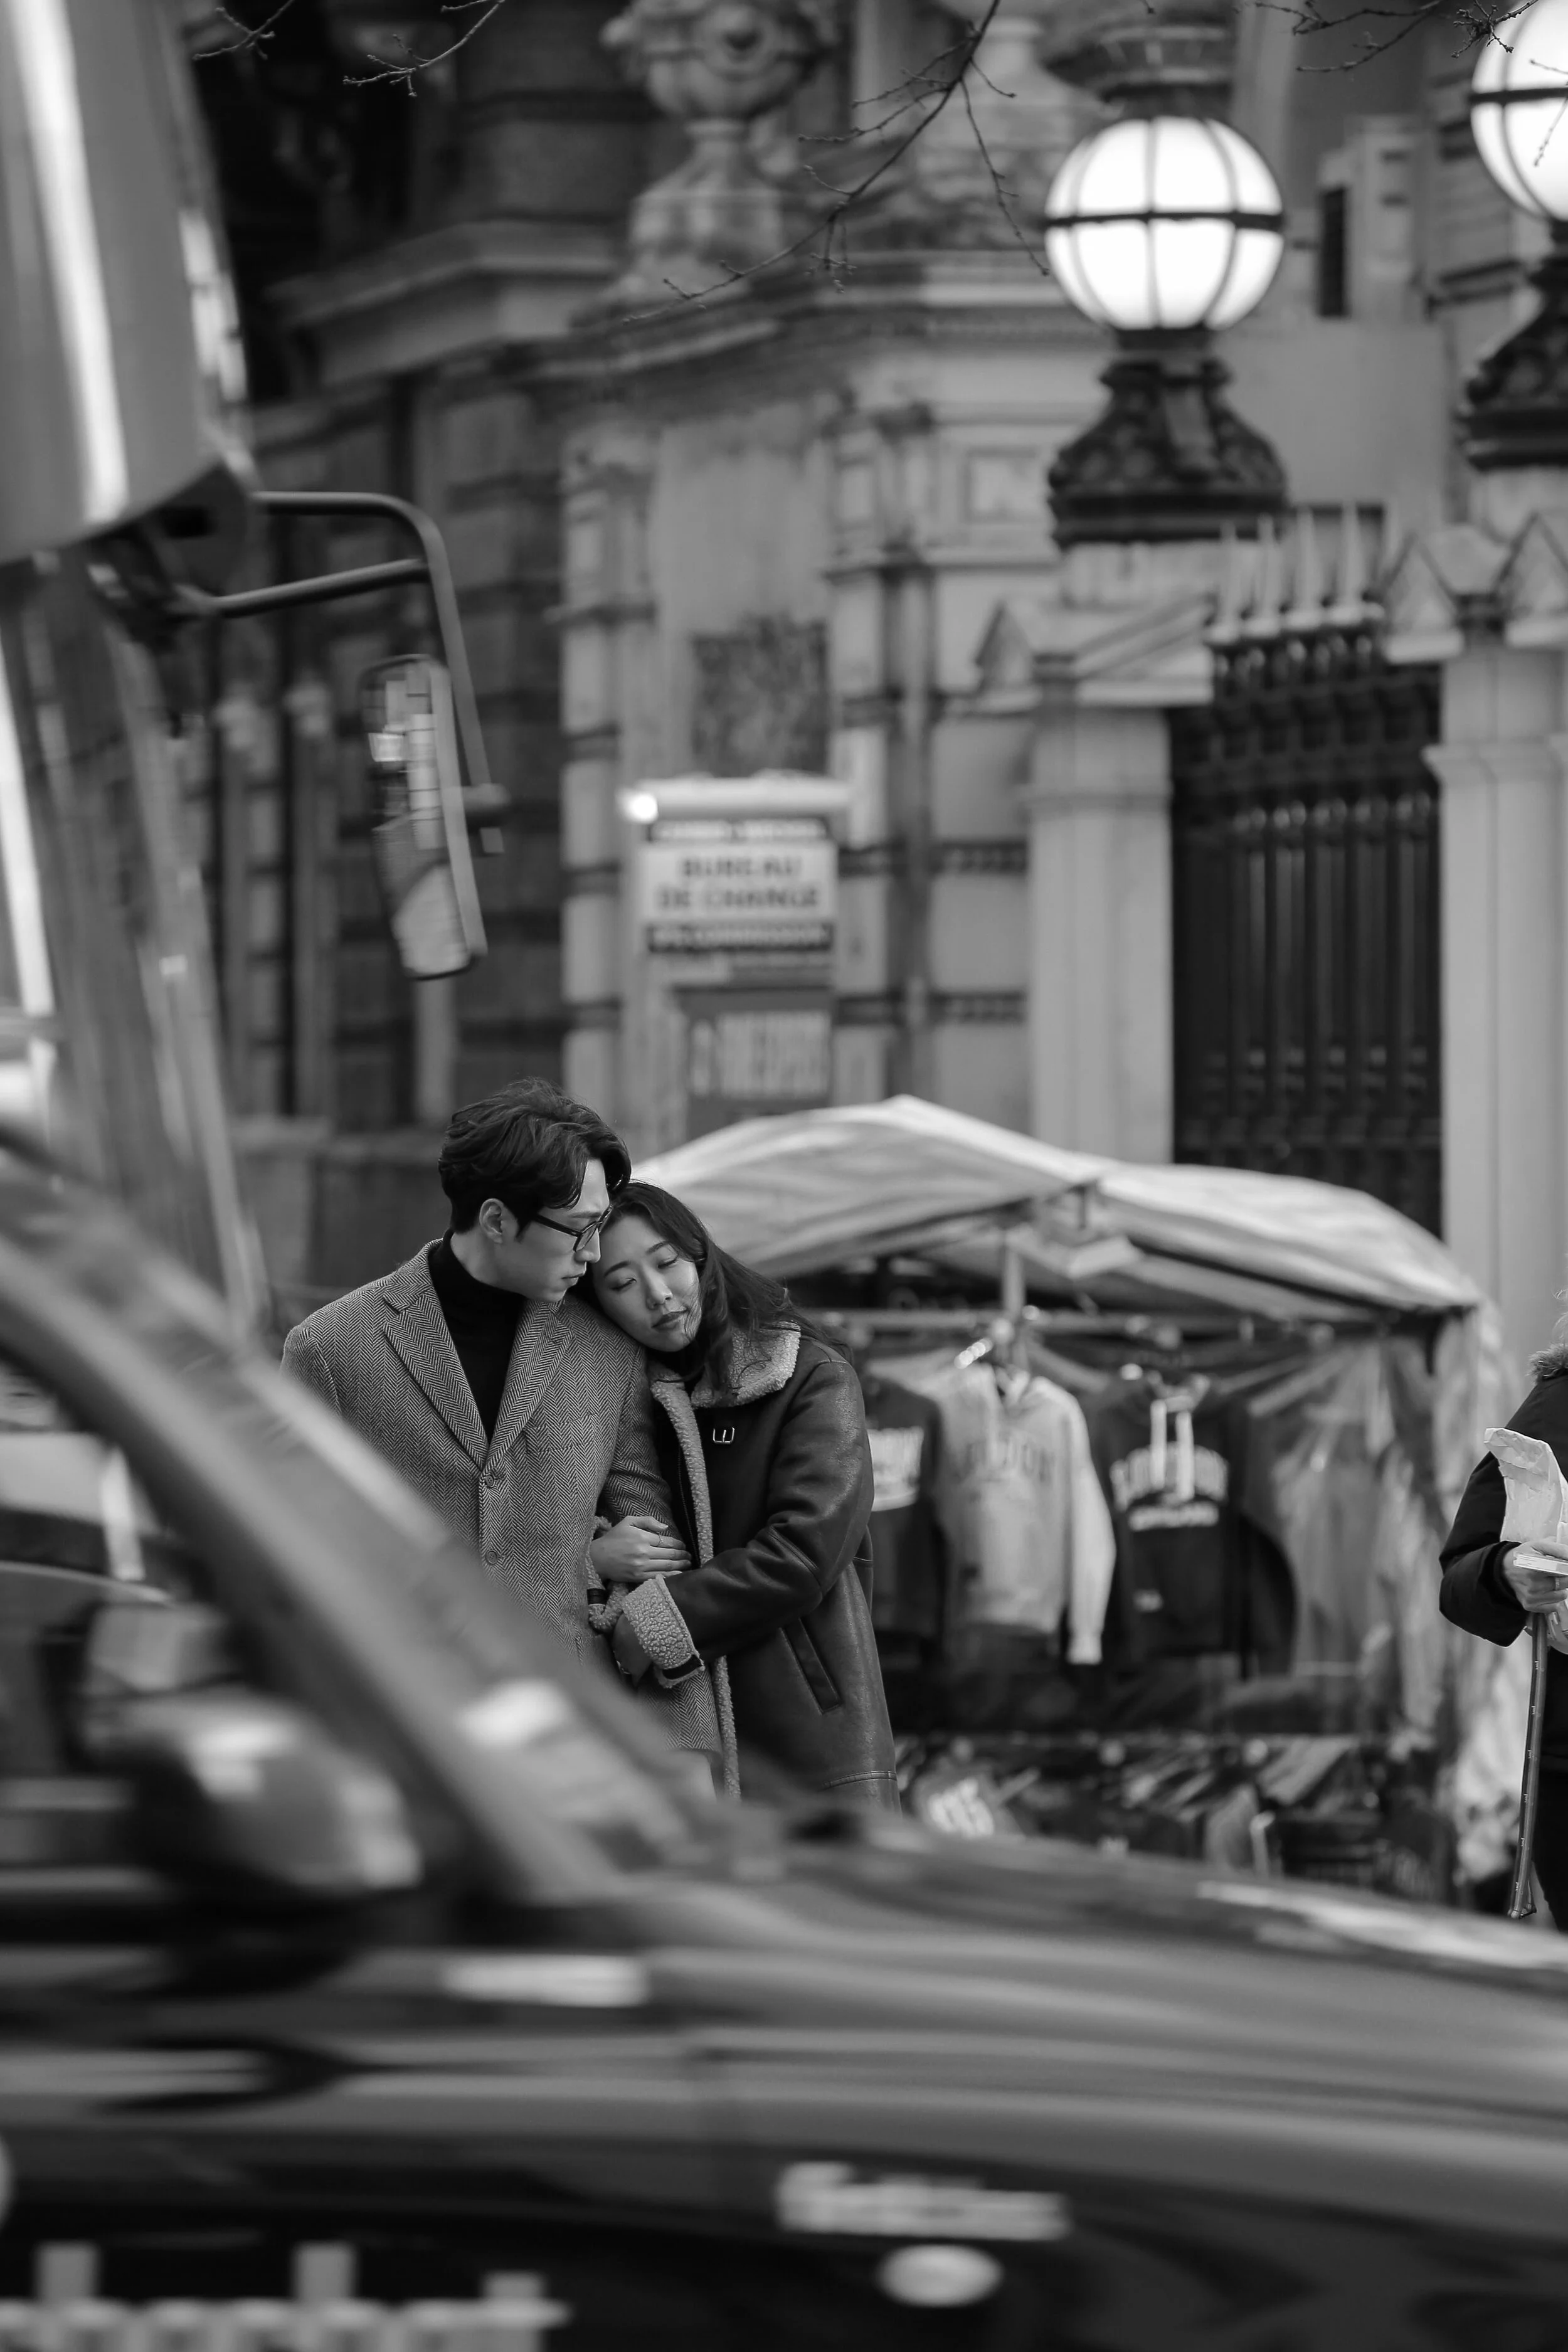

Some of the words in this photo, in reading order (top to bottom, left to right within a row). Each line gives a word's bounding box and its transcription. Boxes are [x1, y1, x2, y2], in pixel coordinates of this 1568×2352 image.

[682, 856, 802, 877] BUREAU
[659, 887, 691, 908] DE
[704, 887, 819, 908] CHANGE
